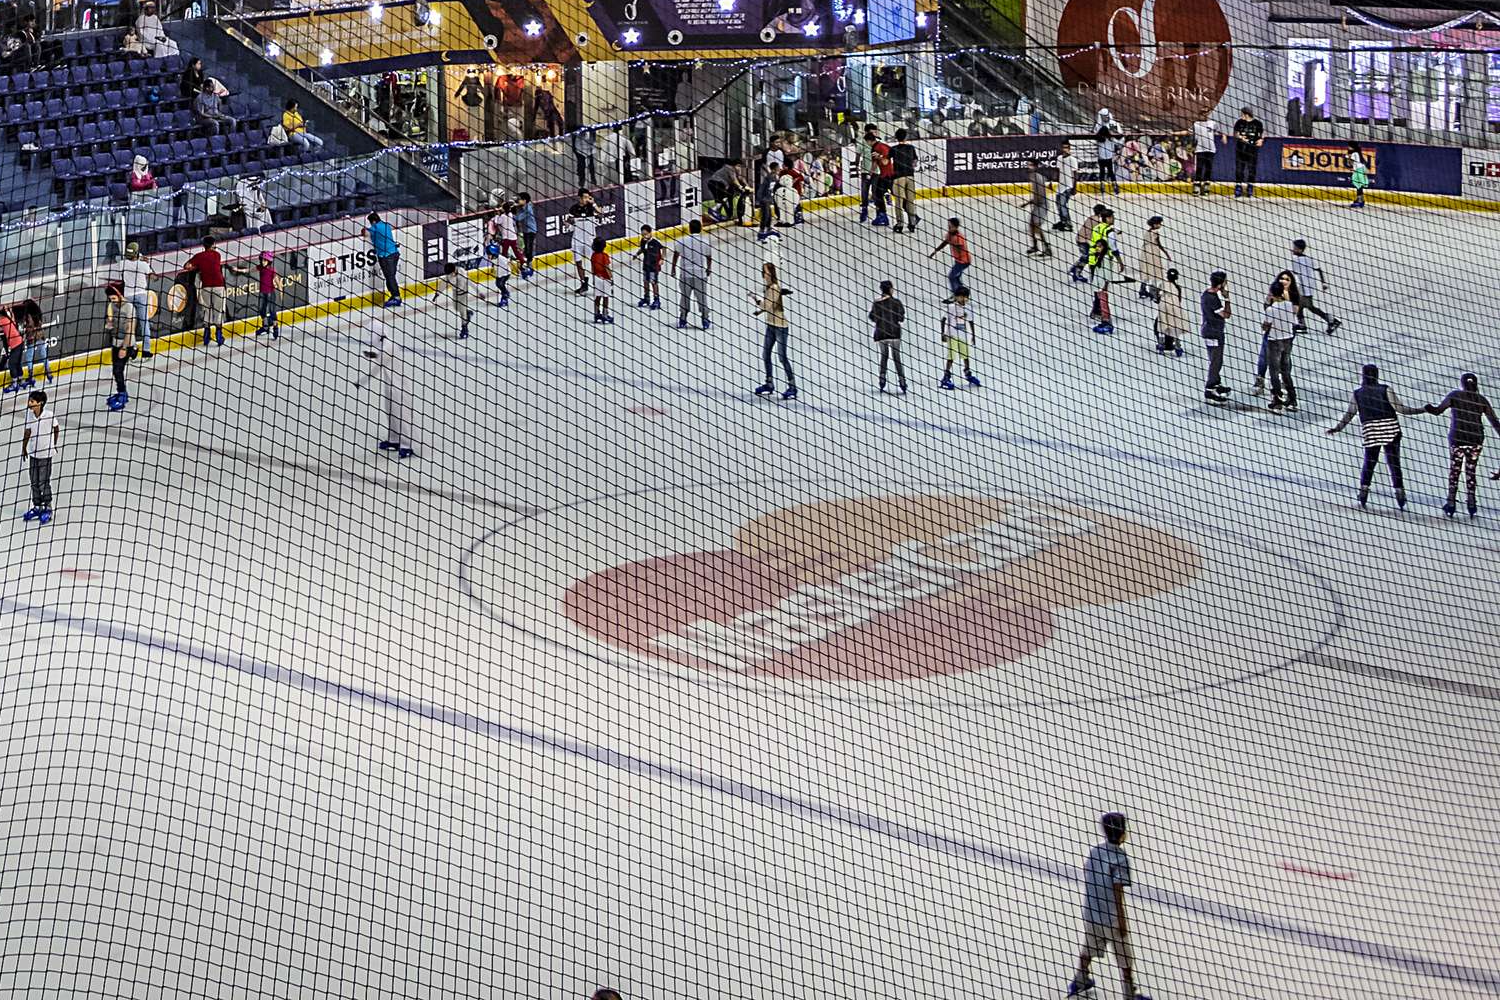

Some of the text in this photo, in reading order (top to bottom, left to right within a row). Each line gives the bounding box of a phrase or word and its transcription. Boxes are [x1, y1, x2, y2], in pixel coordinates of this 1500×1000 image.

[1167, 87, 1210, 101] RINK
[976, 160, 1020, 171] EMIRATES
[338, 250, 378, 272] TISS
